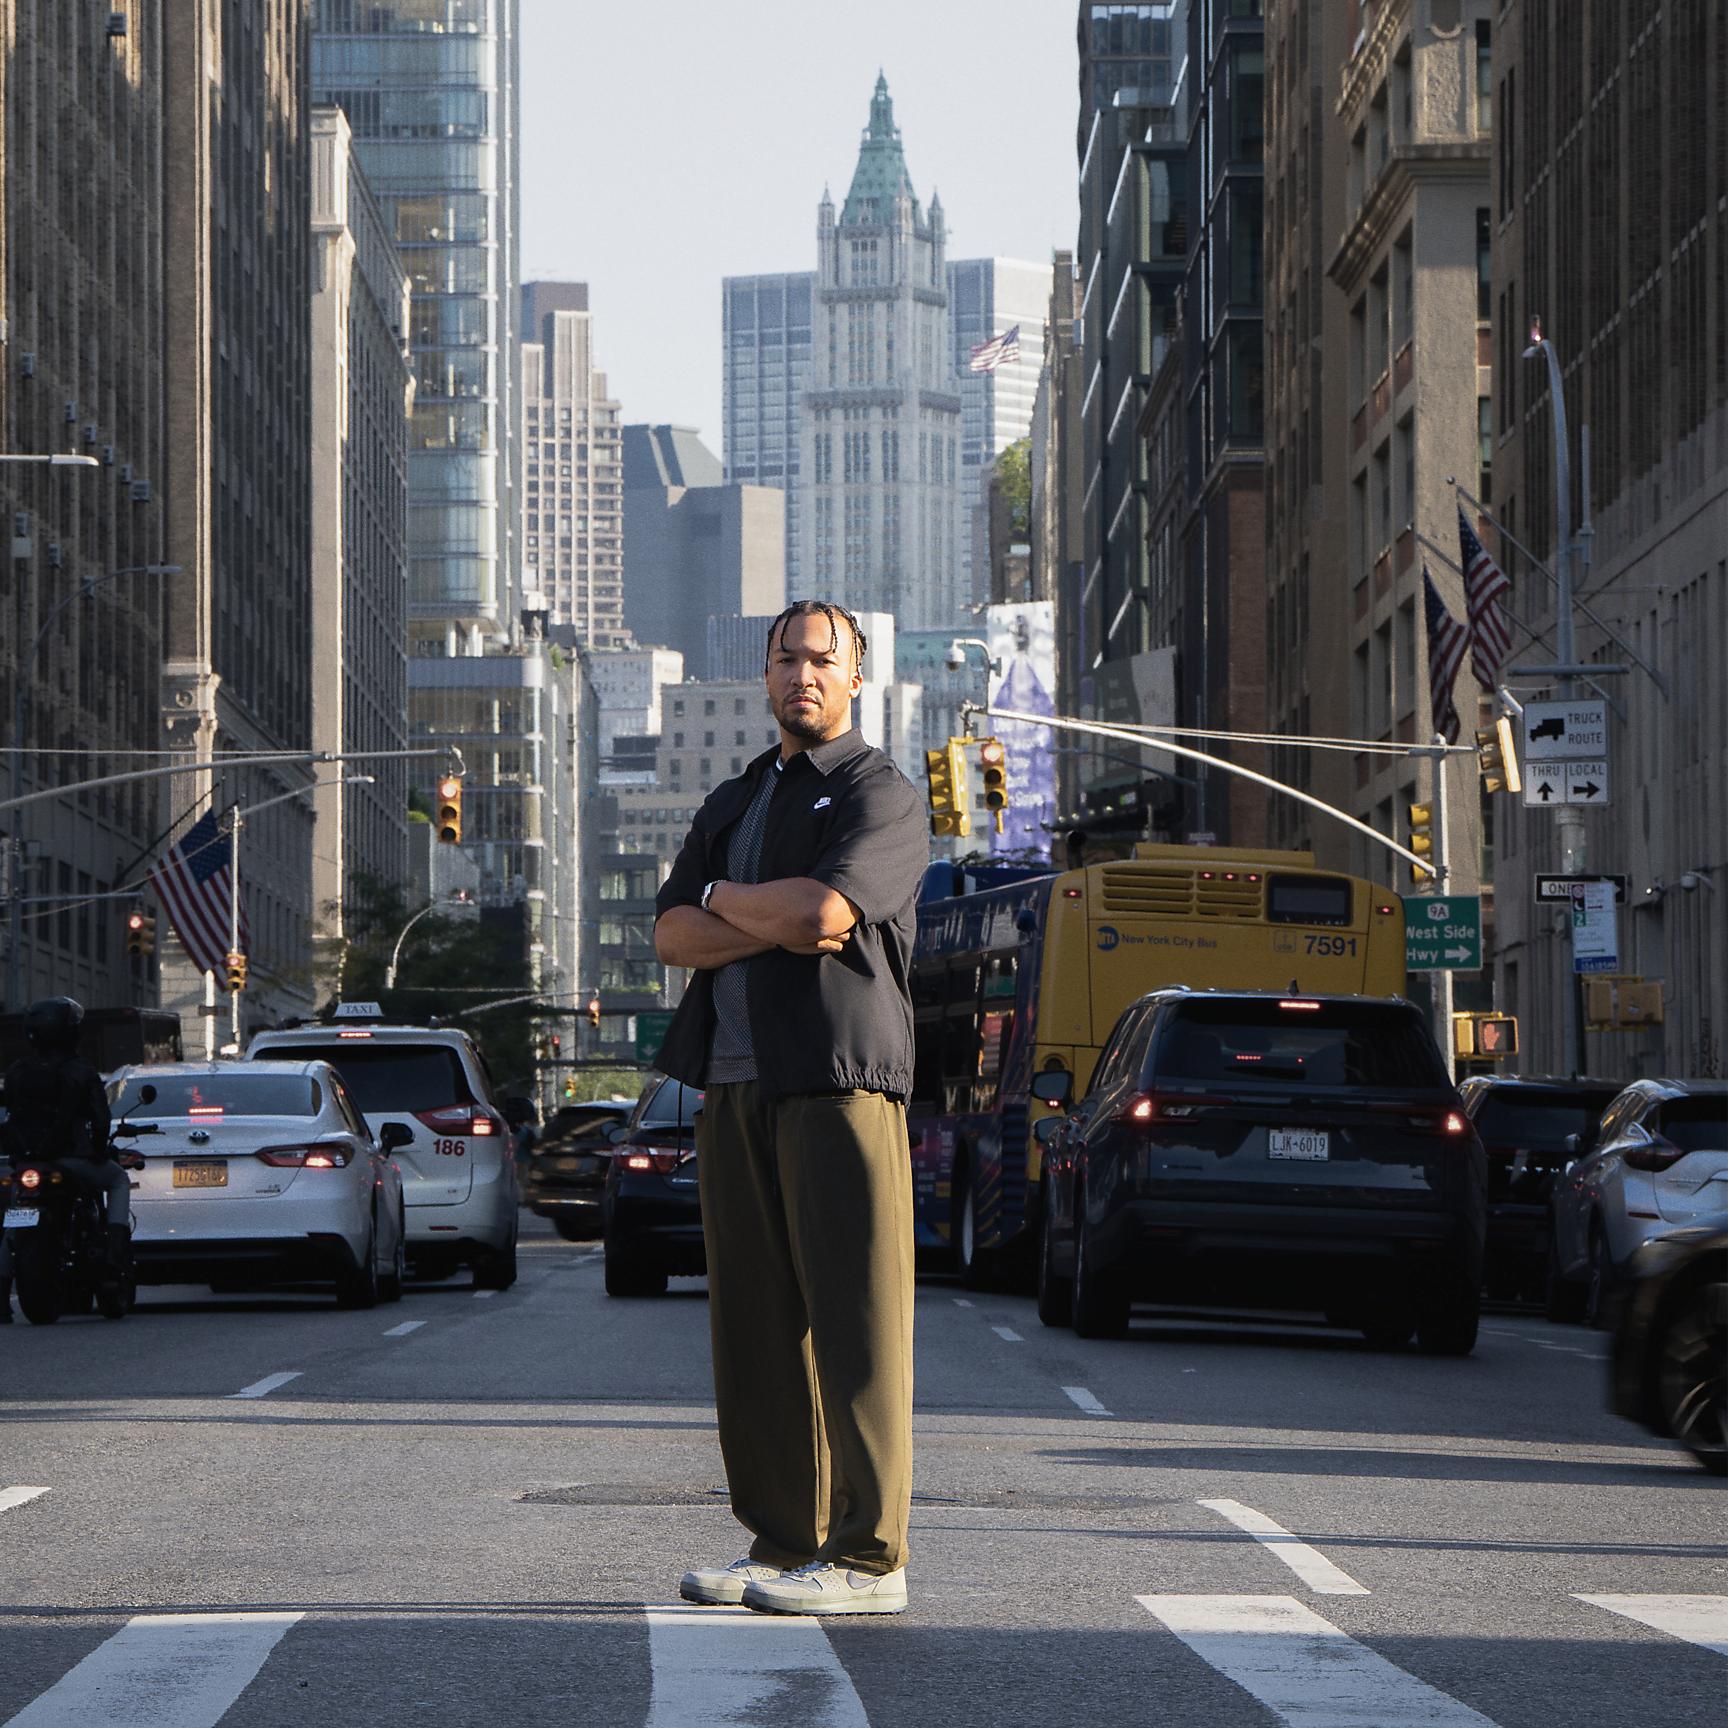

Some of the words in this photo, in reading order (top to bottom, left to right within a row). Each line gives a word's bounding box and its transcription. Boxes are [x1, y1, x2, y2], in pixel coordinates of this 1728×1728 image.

[1567, 713, 1602, 724] TRUCK
[1568, 732, 1603, 744] ROUTE
[1532, 766, 1560, 776] THRU
[1569, 764, 1604, 775] LOCAL
[1430, 906, 1447, 918] 9A
[1444, 925, 1475, 939] Side
[1121, 935, 1145, 945] New
[1148, 935, 1169, 945] York
[1173, 936, 1194, 949] City
[1197, 937, 1217, 948] Bus
[1305, 935, 1357, 957] 7591
[1406, 947, 1438, 963] Hwy
[344, 1005, 372, 1014] TAXI
[433, 1139, 465, 1156] 186
